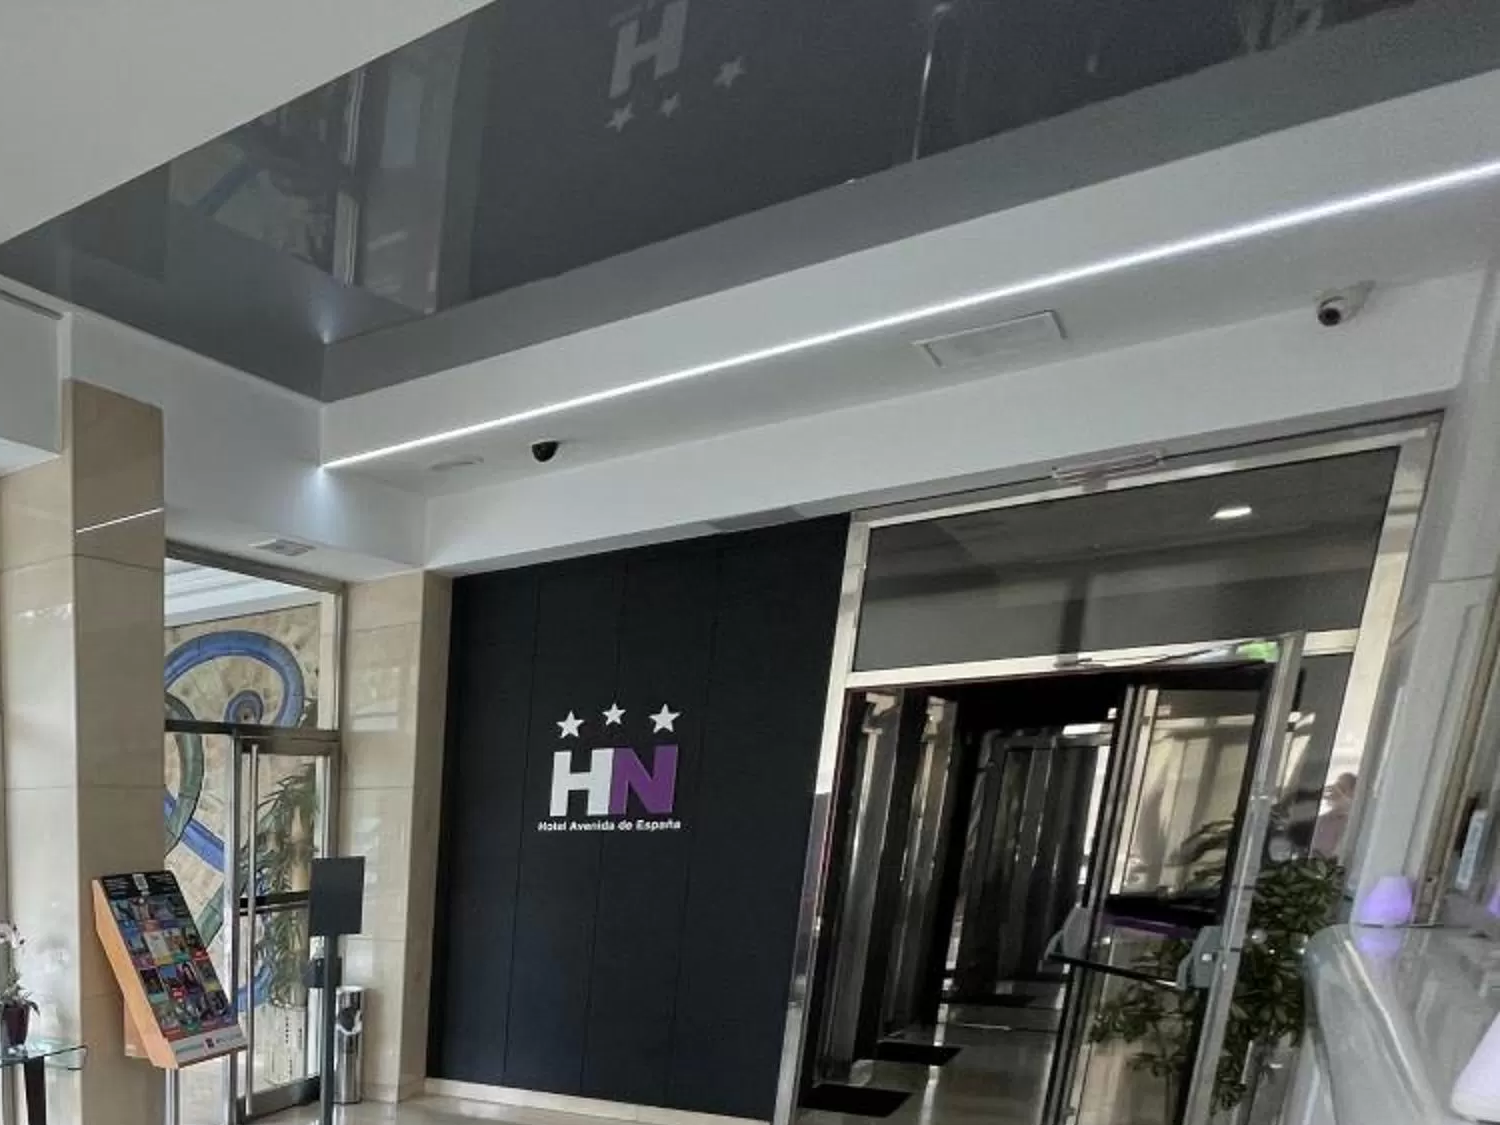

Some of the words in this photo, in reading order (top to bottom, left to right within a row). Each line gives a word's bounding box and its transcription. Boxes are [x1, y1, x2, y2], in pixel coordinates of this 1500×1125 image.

[550, 744, 679, 817] HN
[538, 821, 567, 832] Hotel
[569, 820, 616, 832] Avenida
[618, 819, 634, 831] de
[636, 818, 682, 832] España
